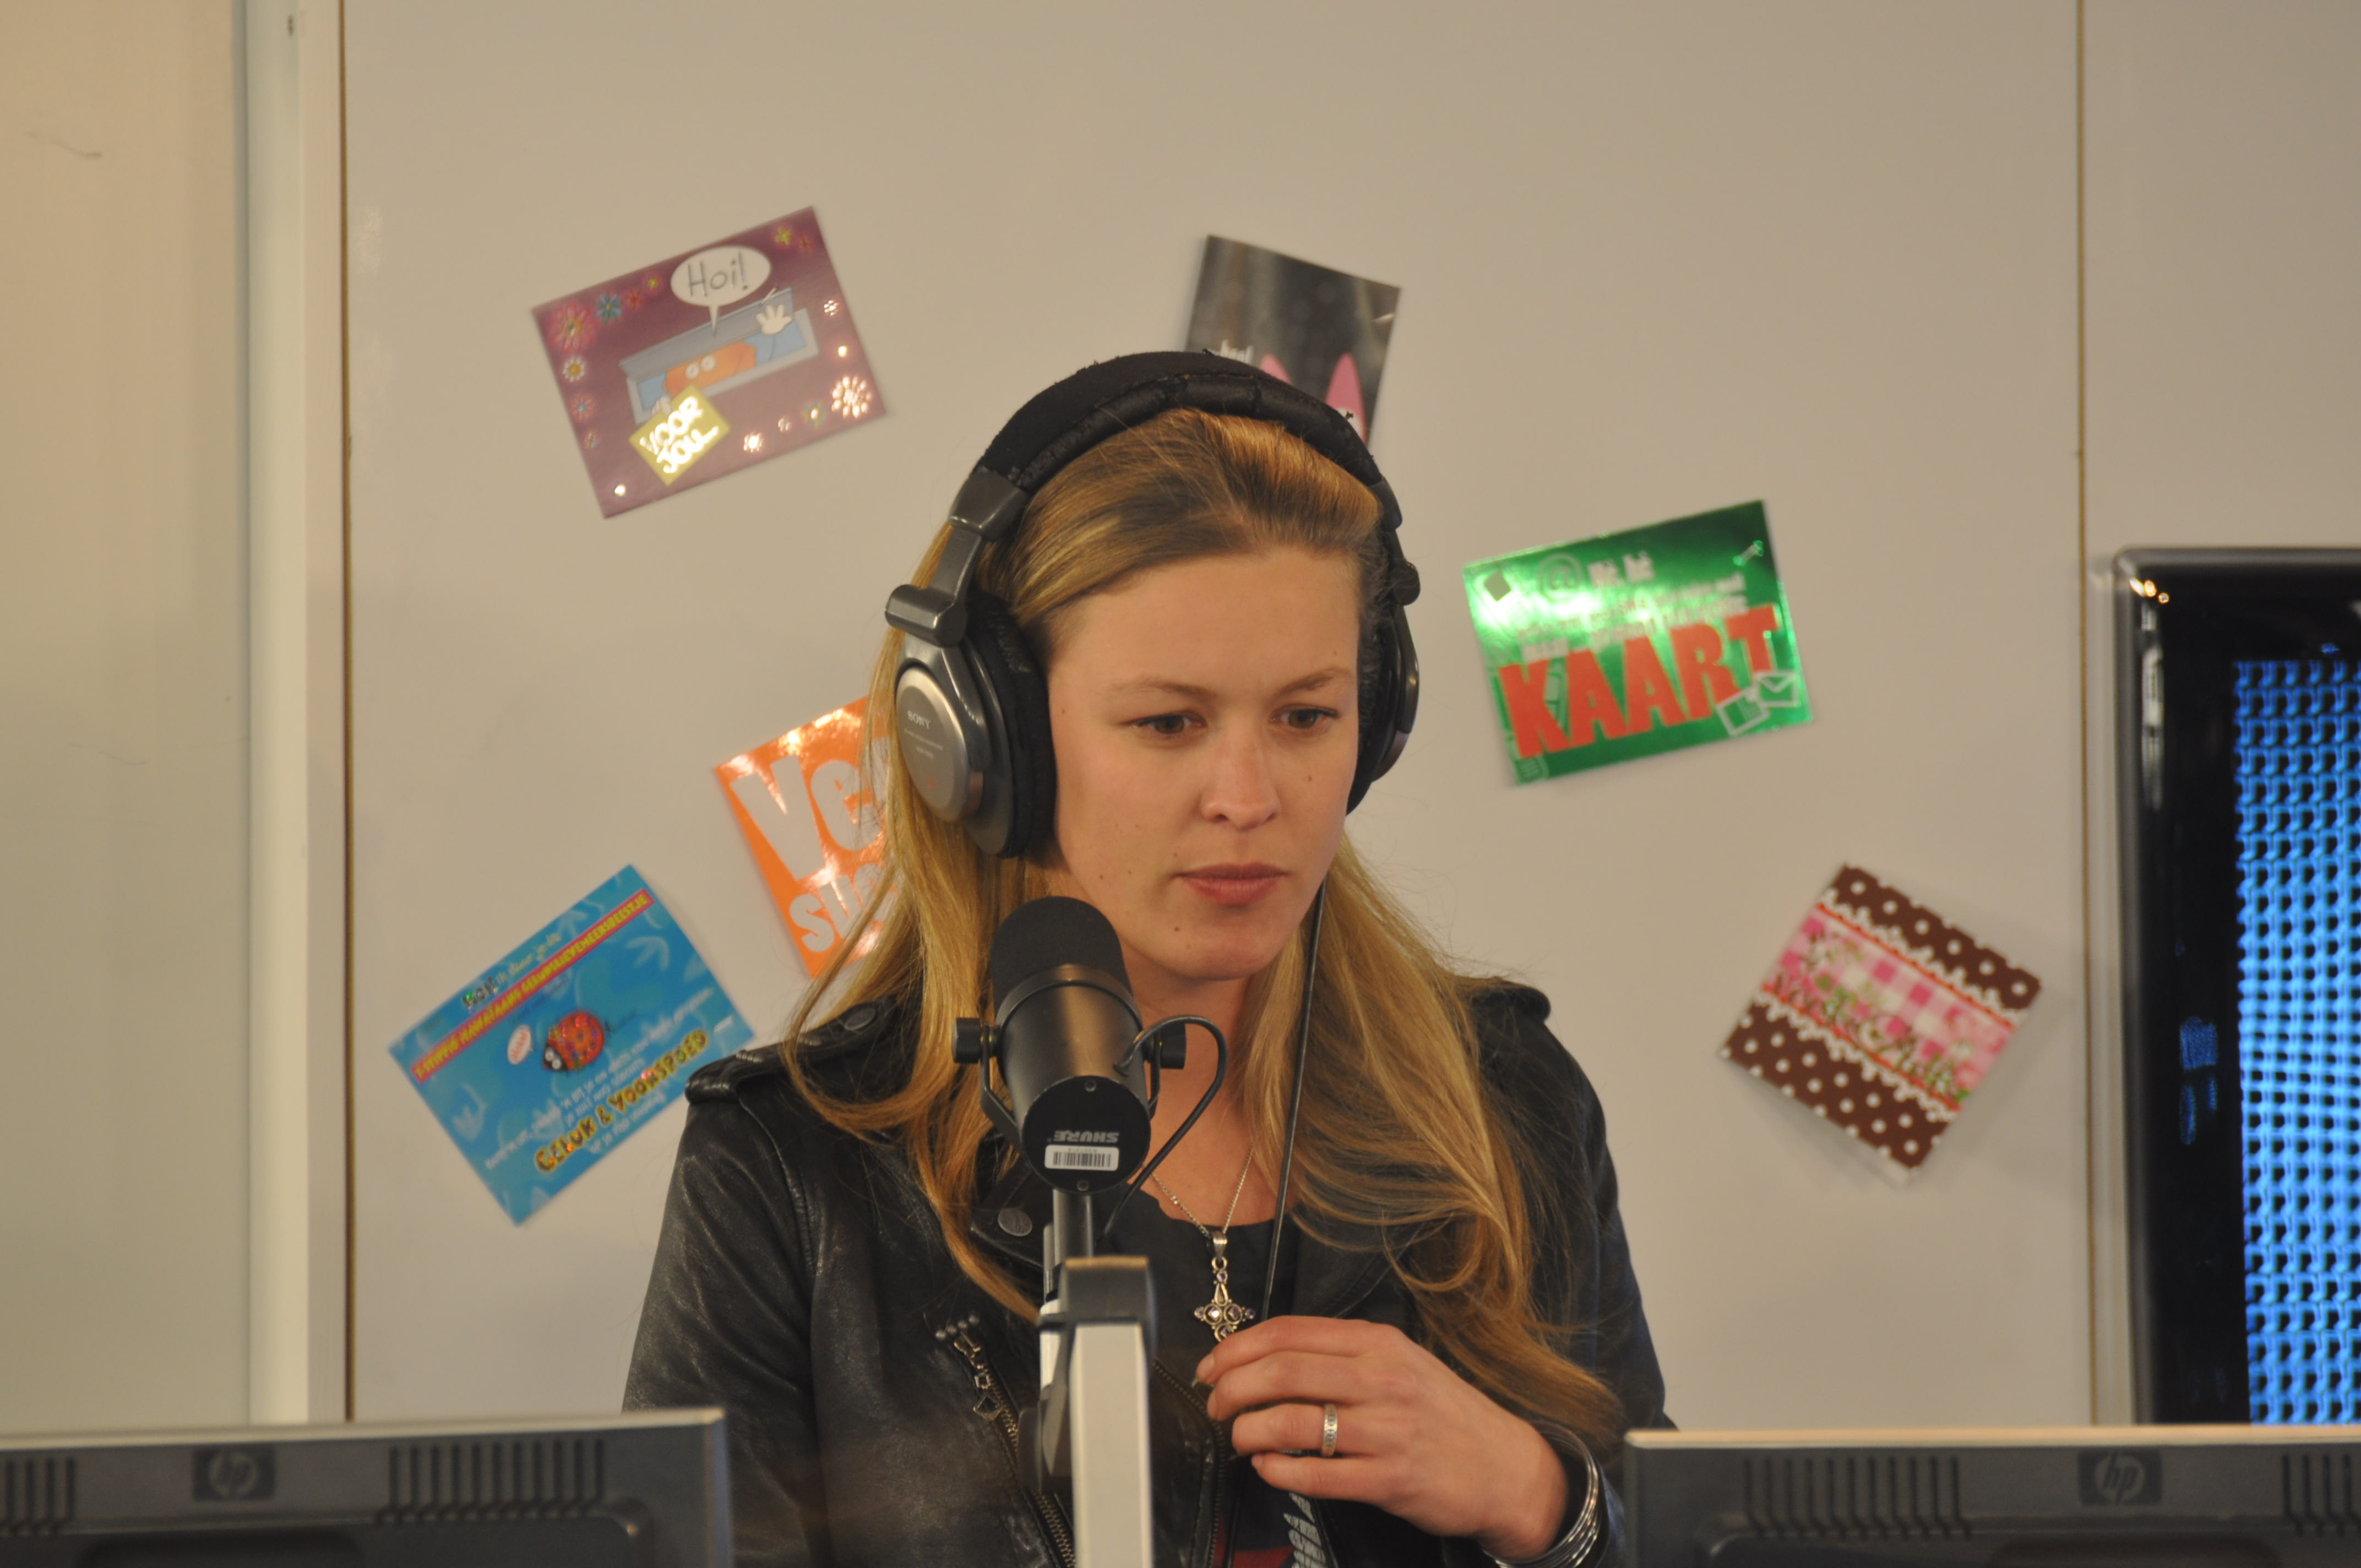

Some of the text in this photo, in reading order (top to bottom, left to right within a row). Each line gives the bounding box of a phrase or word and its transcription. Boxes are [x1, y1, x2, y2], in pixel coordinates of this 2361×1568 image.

[687, 251, 750, 298] Hoi!
[639, 395, 703, 455] VOOR
[1500, 606, 1778, 758] KAART
[907, 709, 931, 729] SONY
[536, 1119, 595, 1172] GELUK
[597, 1106, 612, 1125] &
[611, 1032, 707, 1113] VOORSPOED
[1053, 1129, 1119, 1144] SHURE
